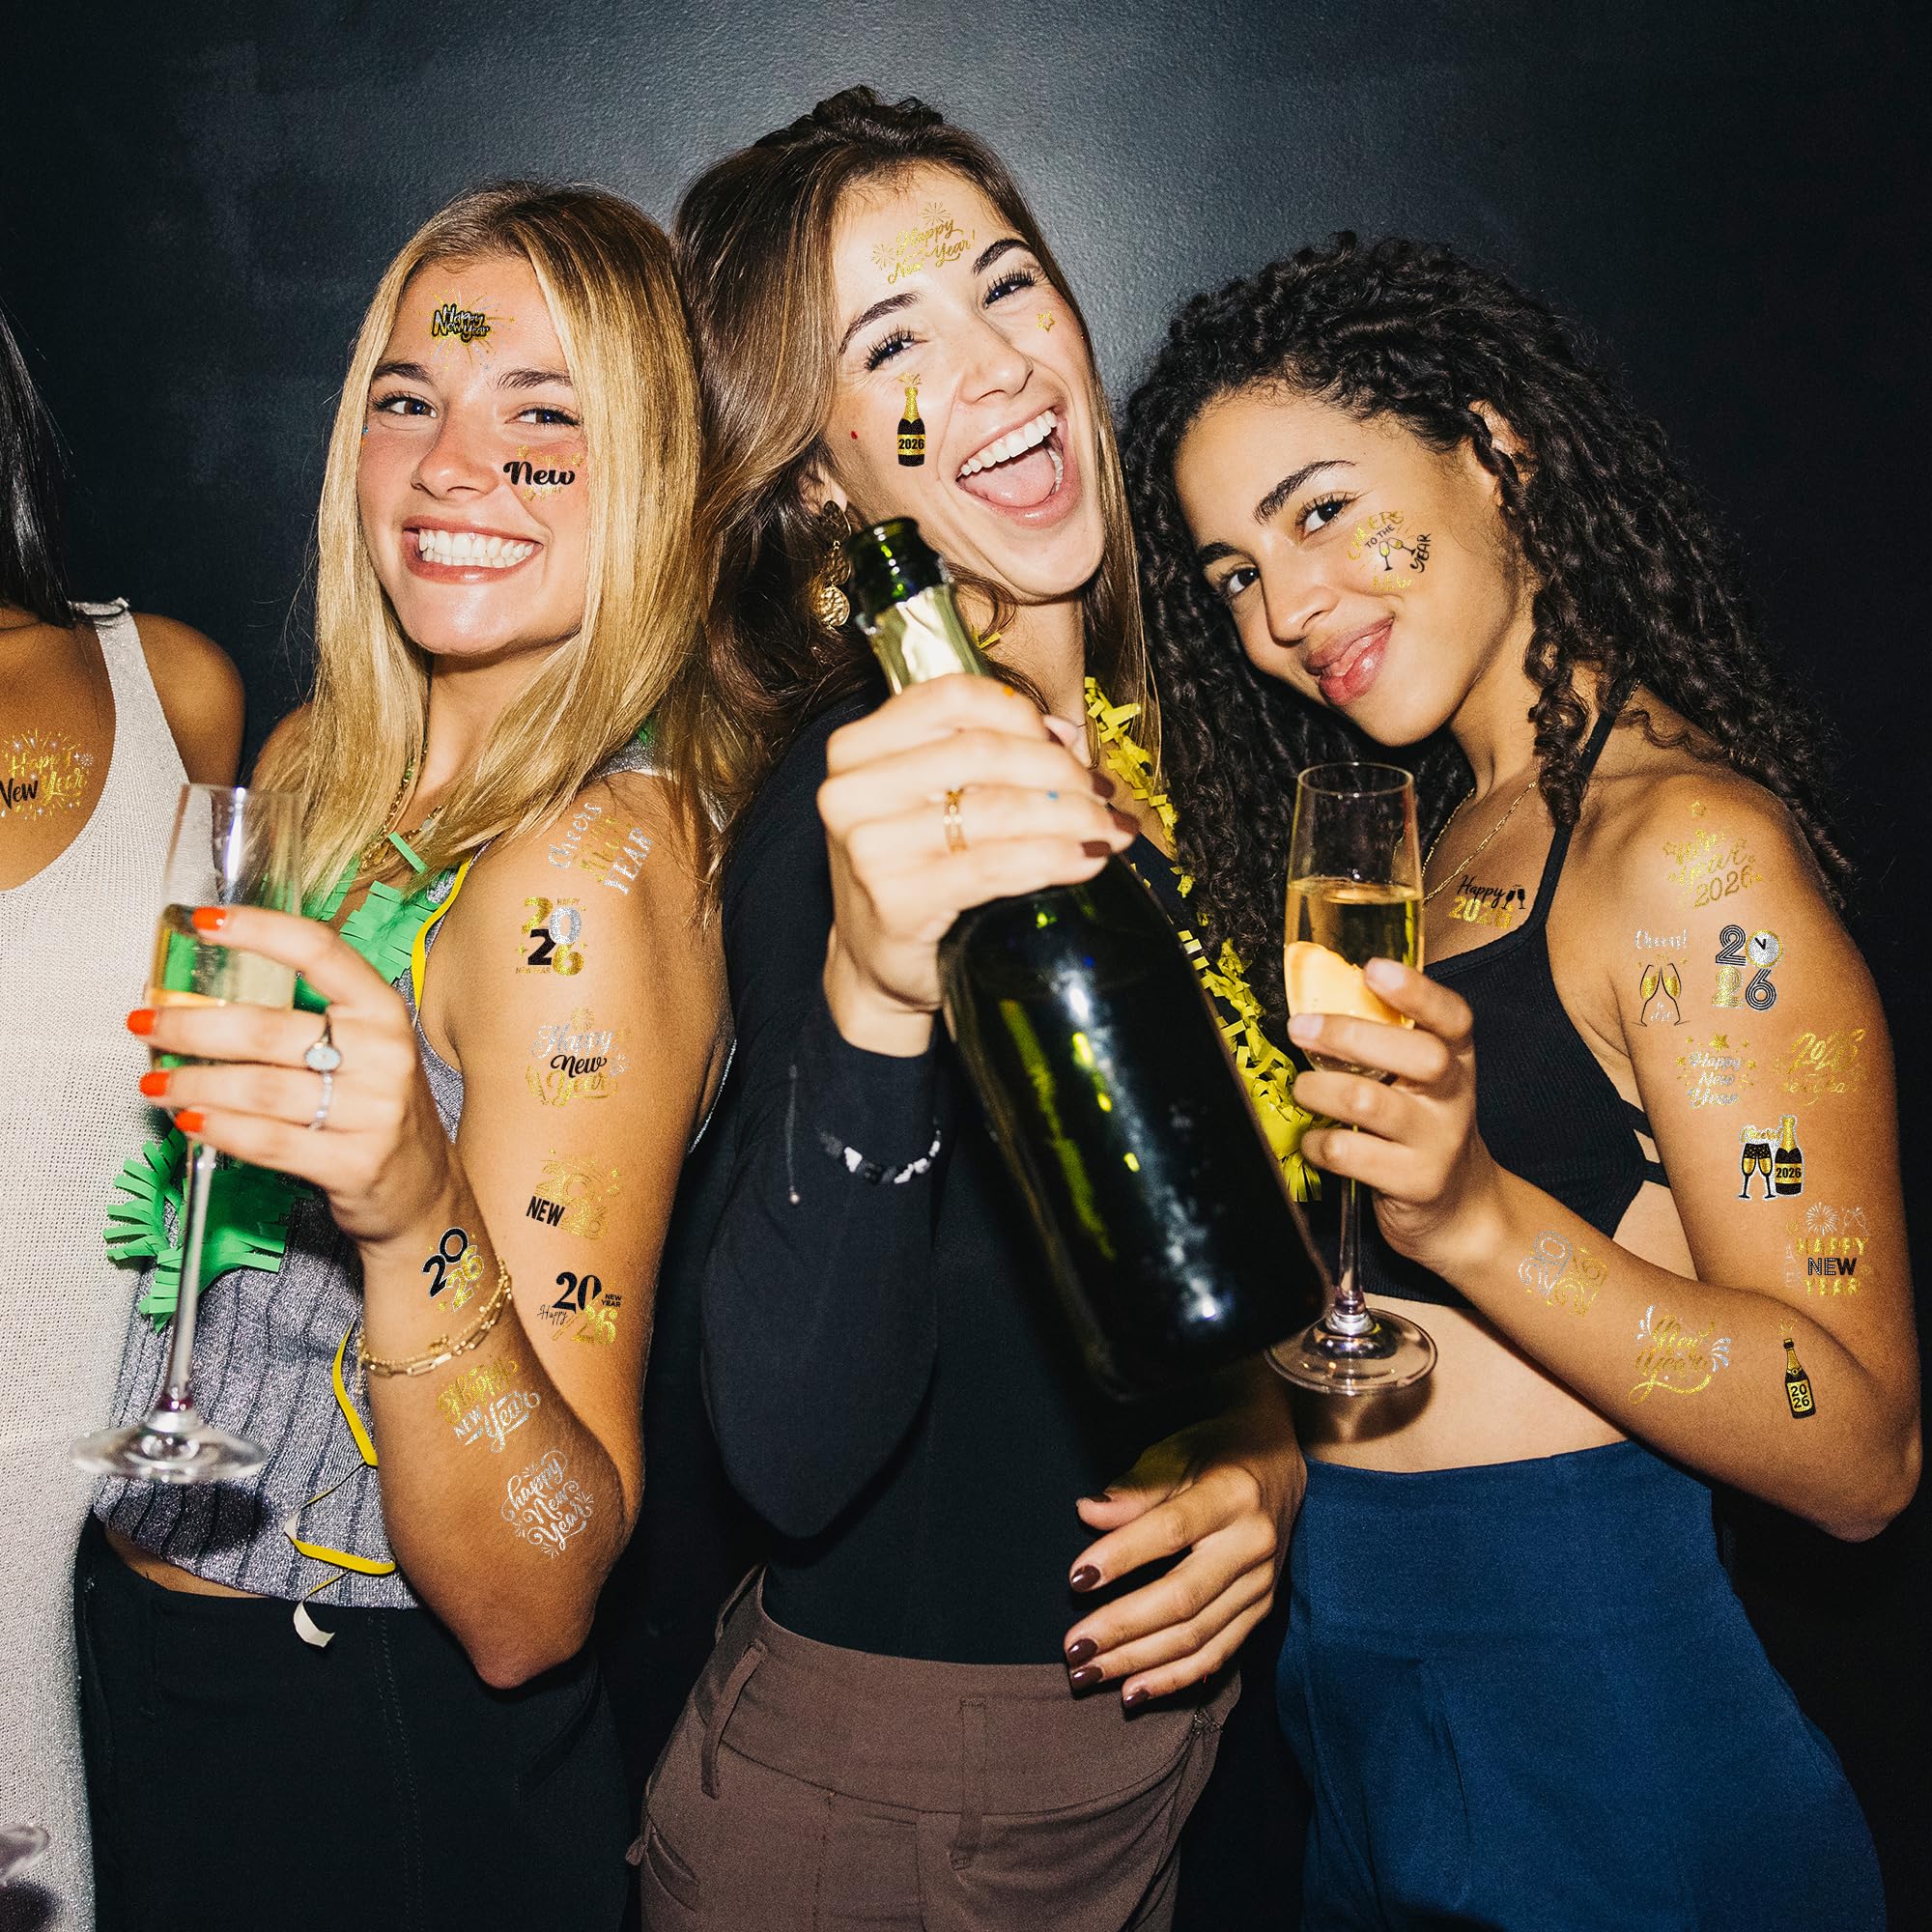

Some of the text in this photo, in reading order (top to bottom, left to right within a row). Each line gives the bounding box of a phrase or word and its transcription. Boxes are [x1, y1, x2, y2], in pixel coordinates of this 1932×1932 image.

[897, 438, 925, 450] 2026
[502, 461, 576, 486] New
[1364, 524, 1396, 550] TO THE
[1409, 532, 1432, 574] YEAR
[603, 828, 653, 895] YEAR
[1457, 874, 1506, 909] Happy
[1694, 865, 1753, 907] 2026
[530, 1023, 616, 1060] Happy
[550, 1054, 608, 1078] New
[1689, 1051, 1743, 1072] Happy
[1776, 1167, 1802, 1179] 2026
[526, 1195, 566, 1227] NEW
[1797, 1237, 1869, 1256] HAPPY
[1808, 1258, 1857, 1275] NEW
[1803, 1277, 1861, 1296] YEAR
[537, 1304, 568, 1325] Happy
[484, 1391, 541, 1454] Year
